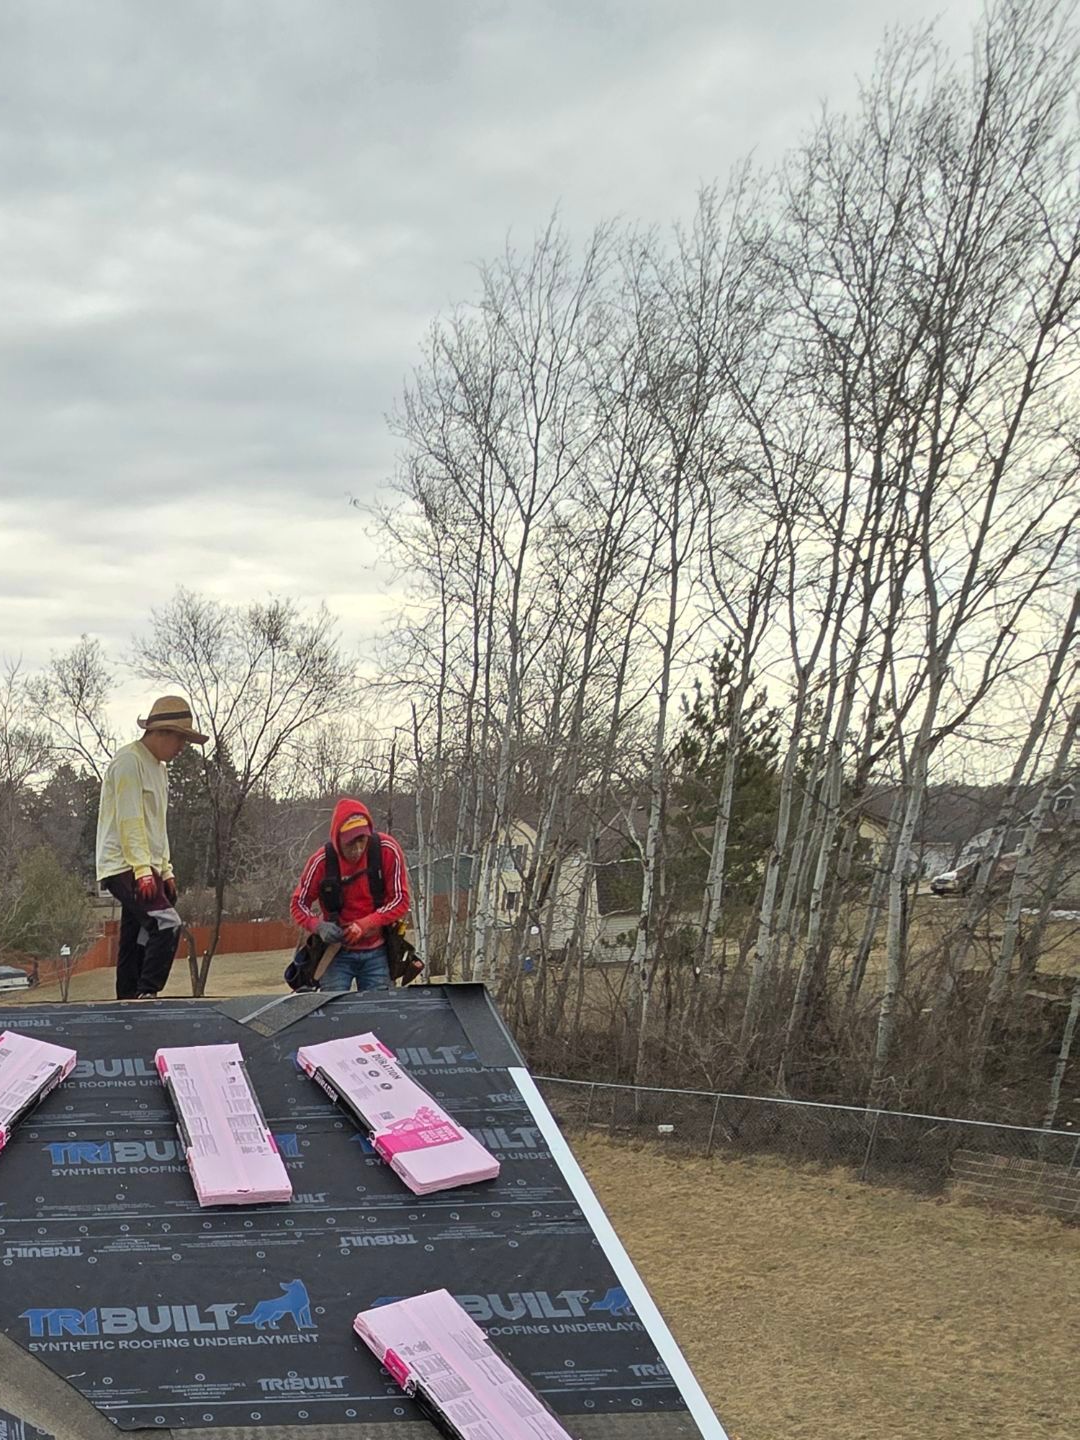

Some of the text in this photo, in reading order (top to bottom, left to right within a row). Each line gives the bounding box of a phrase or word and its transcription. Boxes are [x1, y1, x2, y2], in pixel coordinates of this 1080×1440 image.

[51, 1167, 126, 1177] SYNTHETIC
[339, 1234, 418, 1249] TRIBUILT
[2, 1246, 83, 1259] TRIBUILT
[19, 1303, 238, 1337] TRIBUILT
[28, 1333, 319, 1352] SYNTHETIC ROOFING UNDERLAYMENT
[257, 1375, 348, 1391] TRIBUILT
